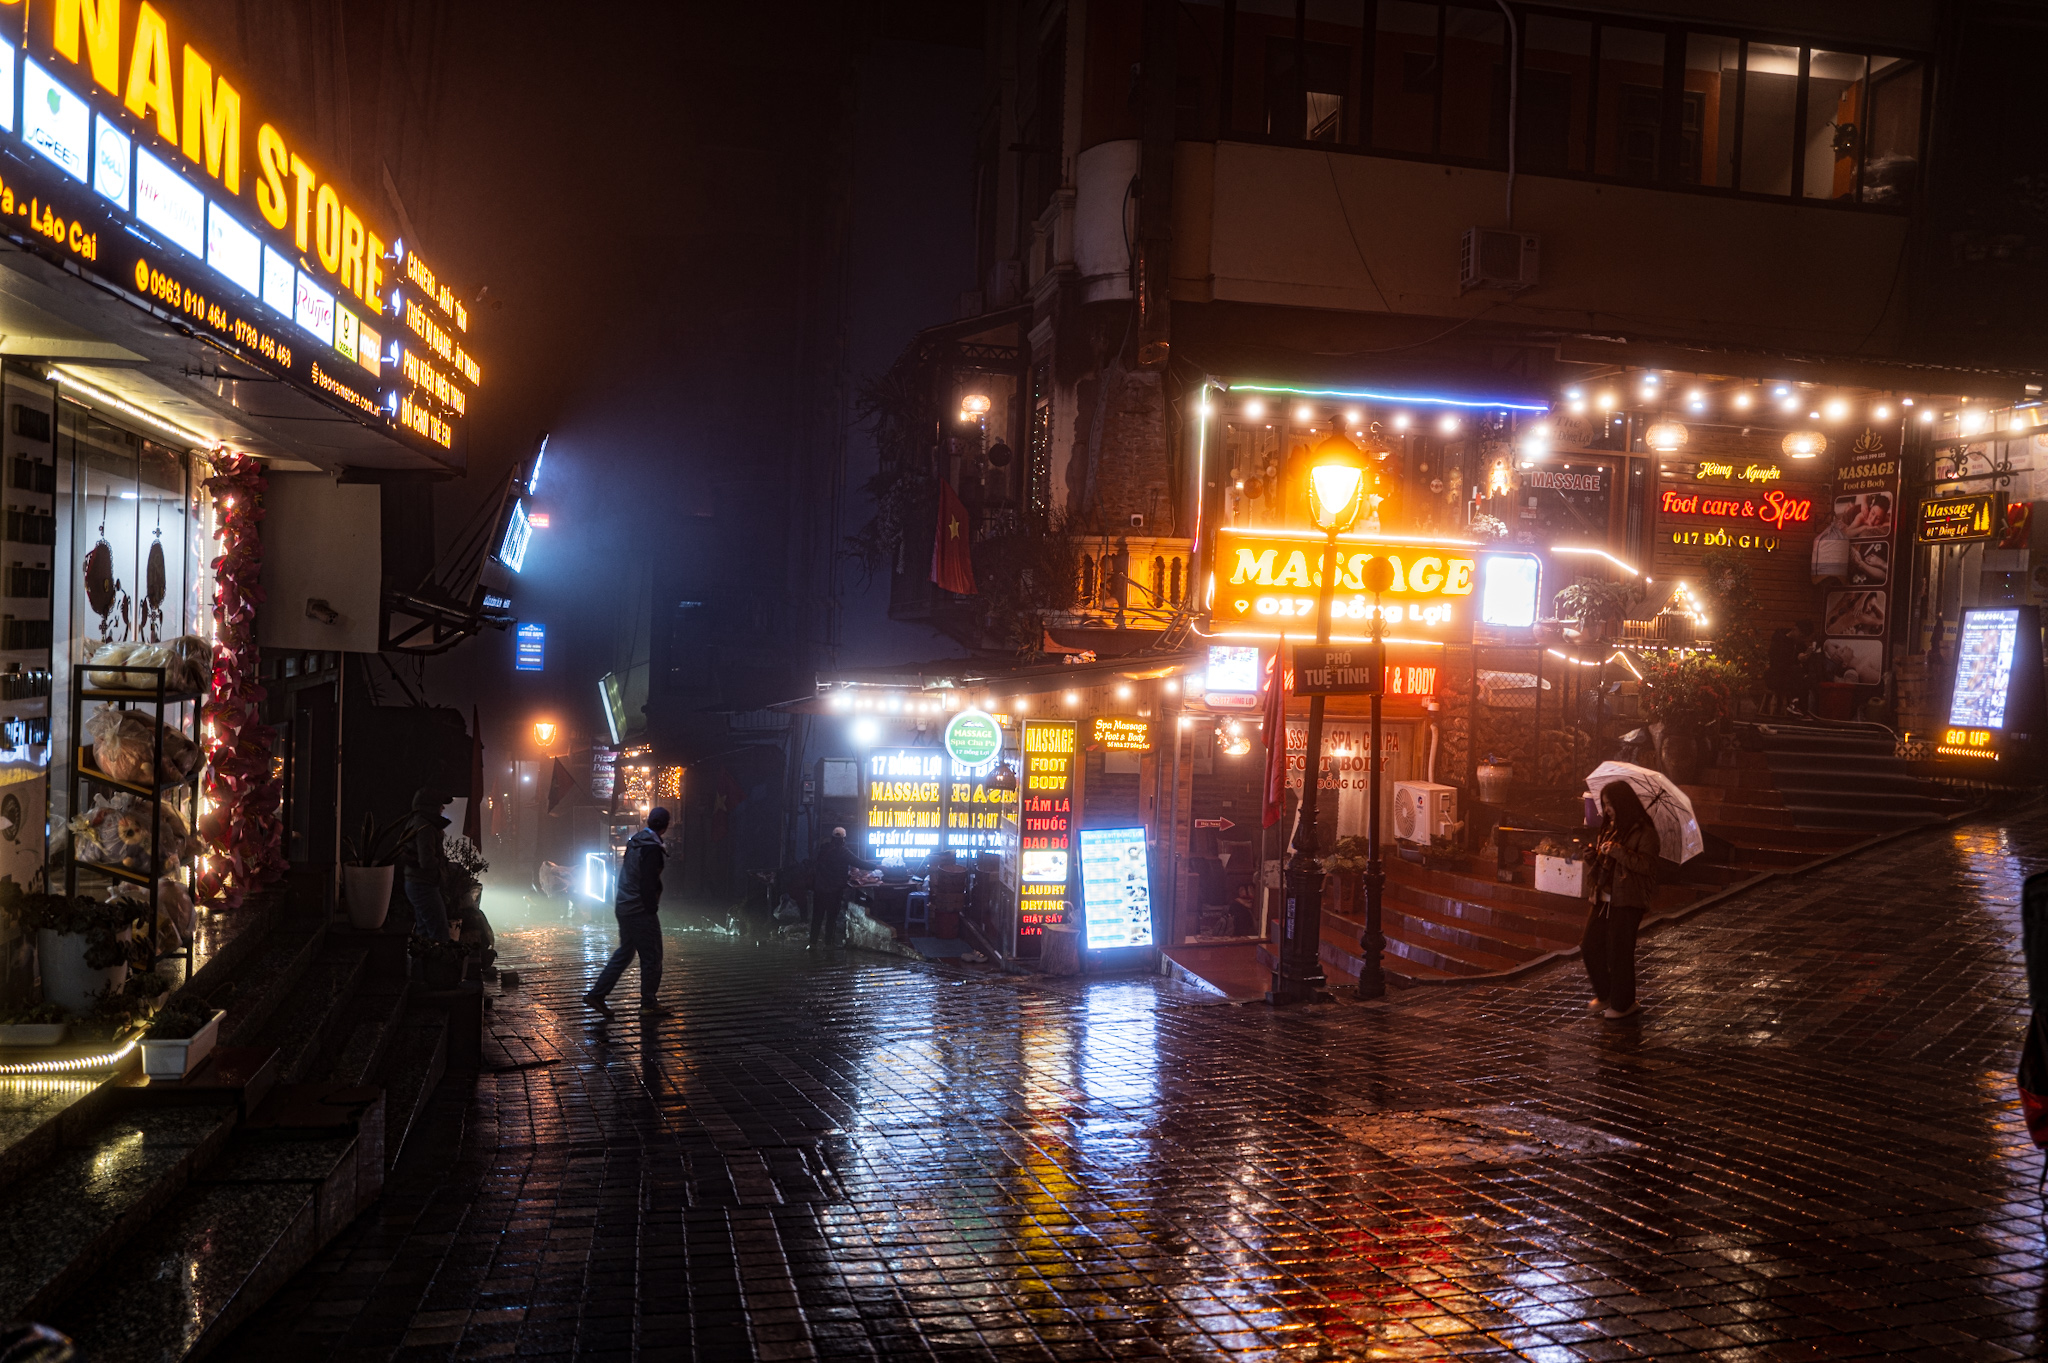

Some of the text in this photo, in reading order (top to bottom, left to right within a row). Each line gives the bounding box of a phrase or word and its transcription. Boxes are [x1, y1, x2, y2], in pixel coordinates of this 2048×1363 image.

[256, 123, 385, 315] STORE
[31, 197, 66, 244] Lào
[69, 221, 97, 262] Cai
[407, 250, 436, 301] CAMERA
[439, 284, 454, 318] MÁY
[297, 283, 332, 327] Ruijie
[150, 268, 181, 308] 0963
[184, 288, 205, 321] 010
[207, 303, 227, 333] 464
[235, 318, 258, 350] 0789
[259, 332, 275, 360] 466
[276, 347, 291, 369] 468
[406, 298, 425, 339] THIẾT
[403, 348, 419, 389] PHỤ
[319, 368, 382, 418] baonamstore.com.vn
[441, 421, 452, 450] EM
[1696, 461, 1781, 483] Hùng Nguyễn
[1837, 461, 1895, 480] MASSAGE
[1531, 471, 1601, 491] MASSAGE
[1843, 482, 1859, 491] Foot
[1867, 478, 1885, 488] Body
[1662, 490, 1811, 530] Foot care & Spa
[1924, 502, 1976, 518] Massage
[1672, 532, 1699, 545] 017
[1704, 528, 1751, 549] ĐỒNG
[1256, 597, 1315, 617] 017
[1408, 602, 1453, 626] Lợi
[1325, 649, 1352, 665] PHỐ
[1304, 665, 1333, 689] TUỆ
[1336, 664, 1370, 685] TĨNH
[1393, 666, 1402, 694] &
[1407, 666, 1436, 695] BODY
[954, 729, 993, 739] MASSAGE
[1095, 719, 1148, 733] Spa Massage
[950, 738, 996, 747] Spa Cha Pa
[1026, 728, 1074, 753] MASSAGE
[1104, 732, 1120, 742] Foot
[1128, 732, 1146, 744] Body
[1331, 730, 1352, 751] SPA
[1946, 730, 1990, 746] GO UP
[871, 755, 888, 776] 17
[923, 755, 942, 780] LỢI
[1030, 757, 1068, 772] FOOT
[1286, 754, 1332, 772] FOT
[871, 781, 941, 803] MASSAGE
[1029, 775, 1068, 790] BODY
[1352, 778, 1368, 792] LỢI
[1054, 797, 1071, 813] LÁ
[884, 808, 893, 828] LÁ
[894, 805, 916, 828] THUỐC
[916, 811, 930, 828] DAO
[930, 806, 941, 828] ĐỎ
[1026, 814, 1067, 831] THUỐC
[1023, 833, 1069, 850] DAO ĐỎ
[1021, 884, 1066, 895] LAUDRY
[1020, 900, 1064, 911] DRYING
[1022, 912, 1063, 925] GIẶT SẤY
[1020, 925, 1036, 936] LẤY
